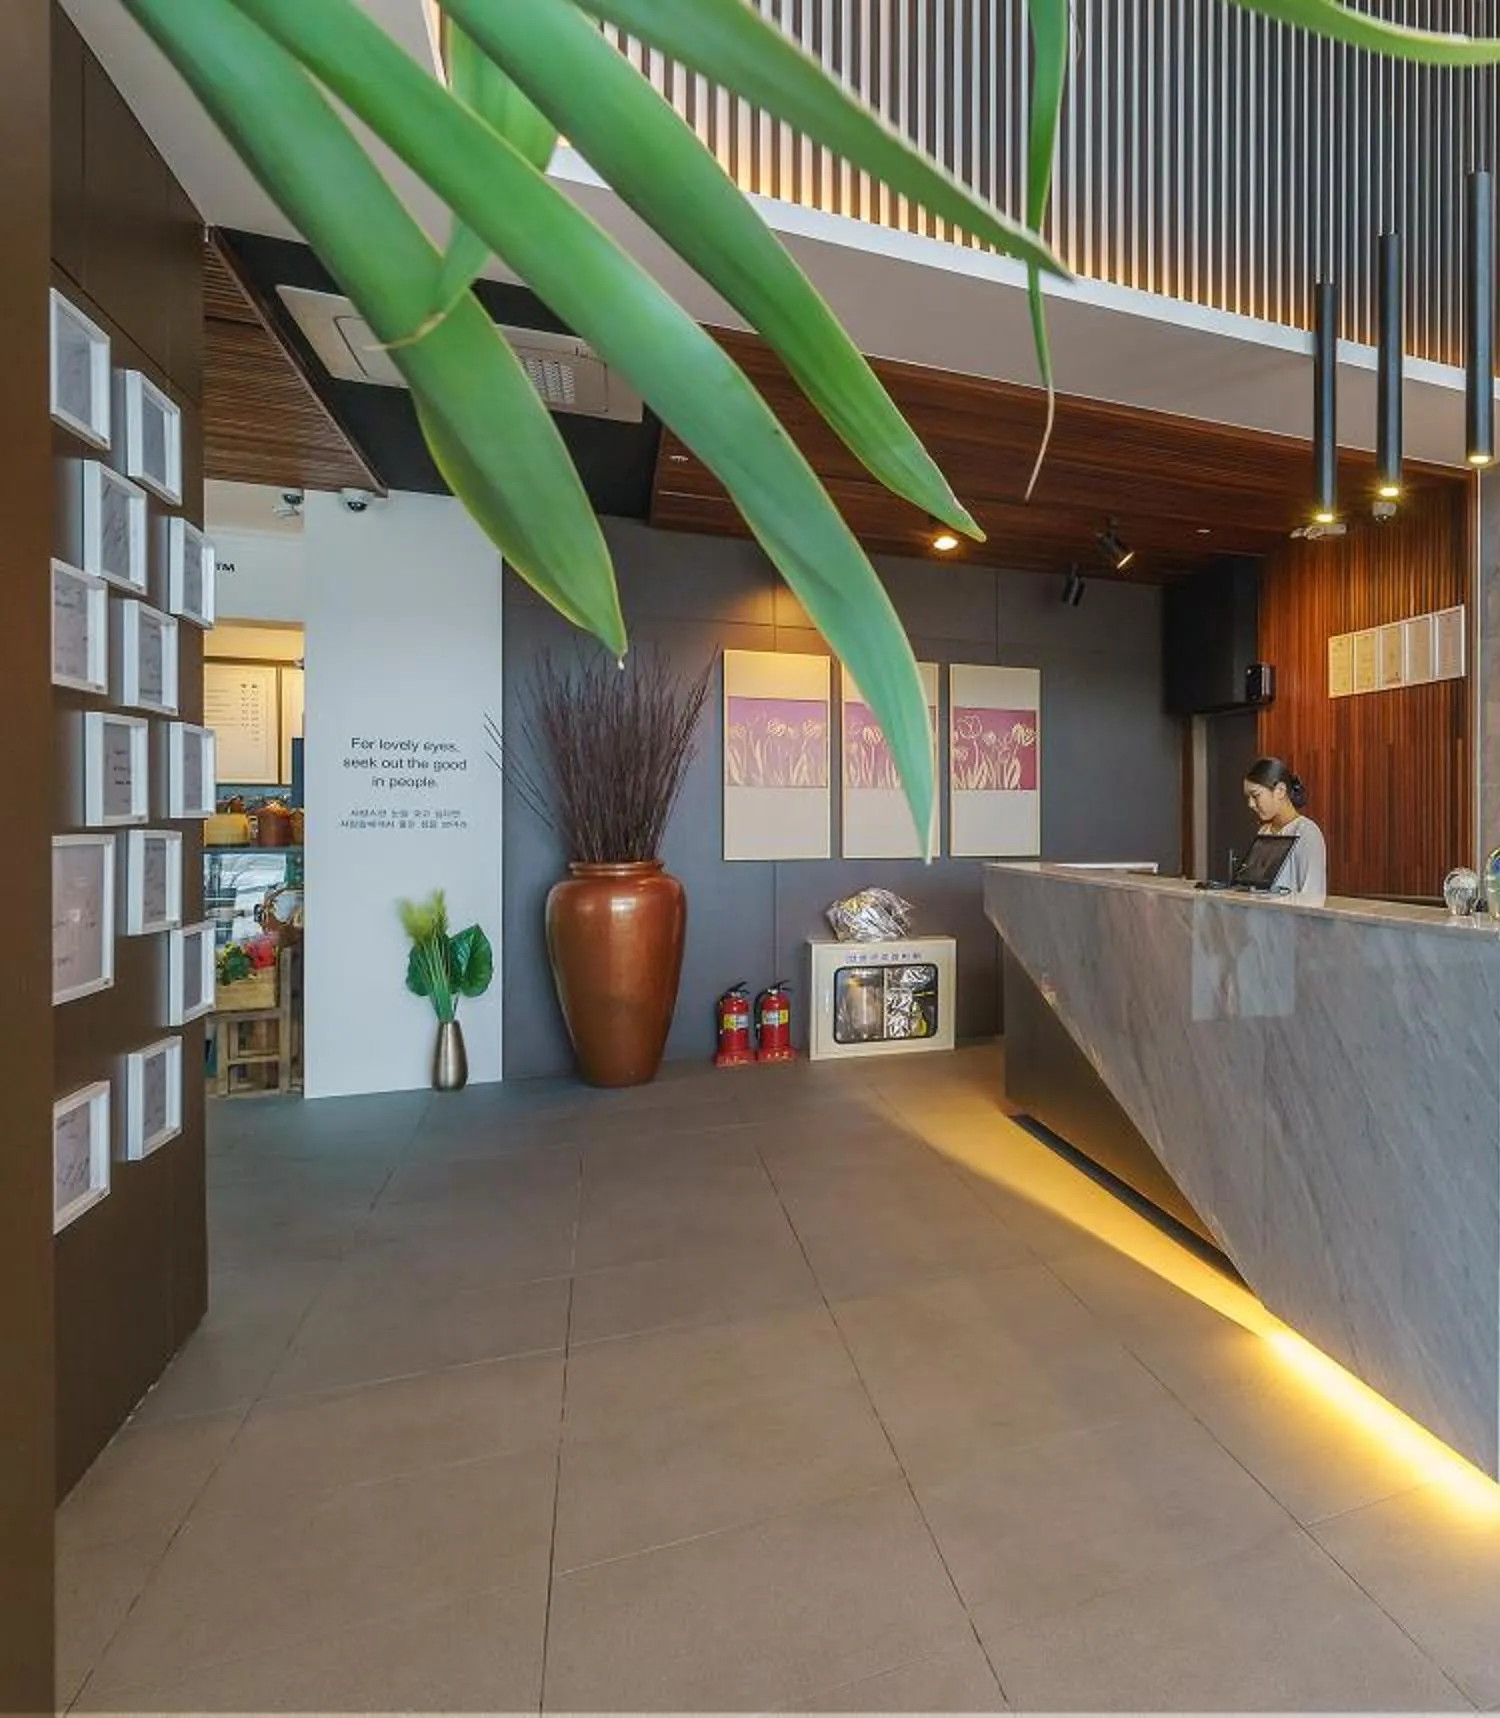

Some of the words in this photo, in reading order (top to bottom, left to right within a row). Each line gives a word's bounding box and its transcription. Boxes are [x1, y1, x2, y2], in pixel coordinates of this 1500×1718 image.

[351, 737, 375, 750] For
[379, 738, 419, 752] lovely
[343, 757, 378, 769] seek
[381, 758, 403, 769] out
[407, 757, 429, 769] the
[433, 759, 467, 772] good
[371, 776, 385, 788] in
